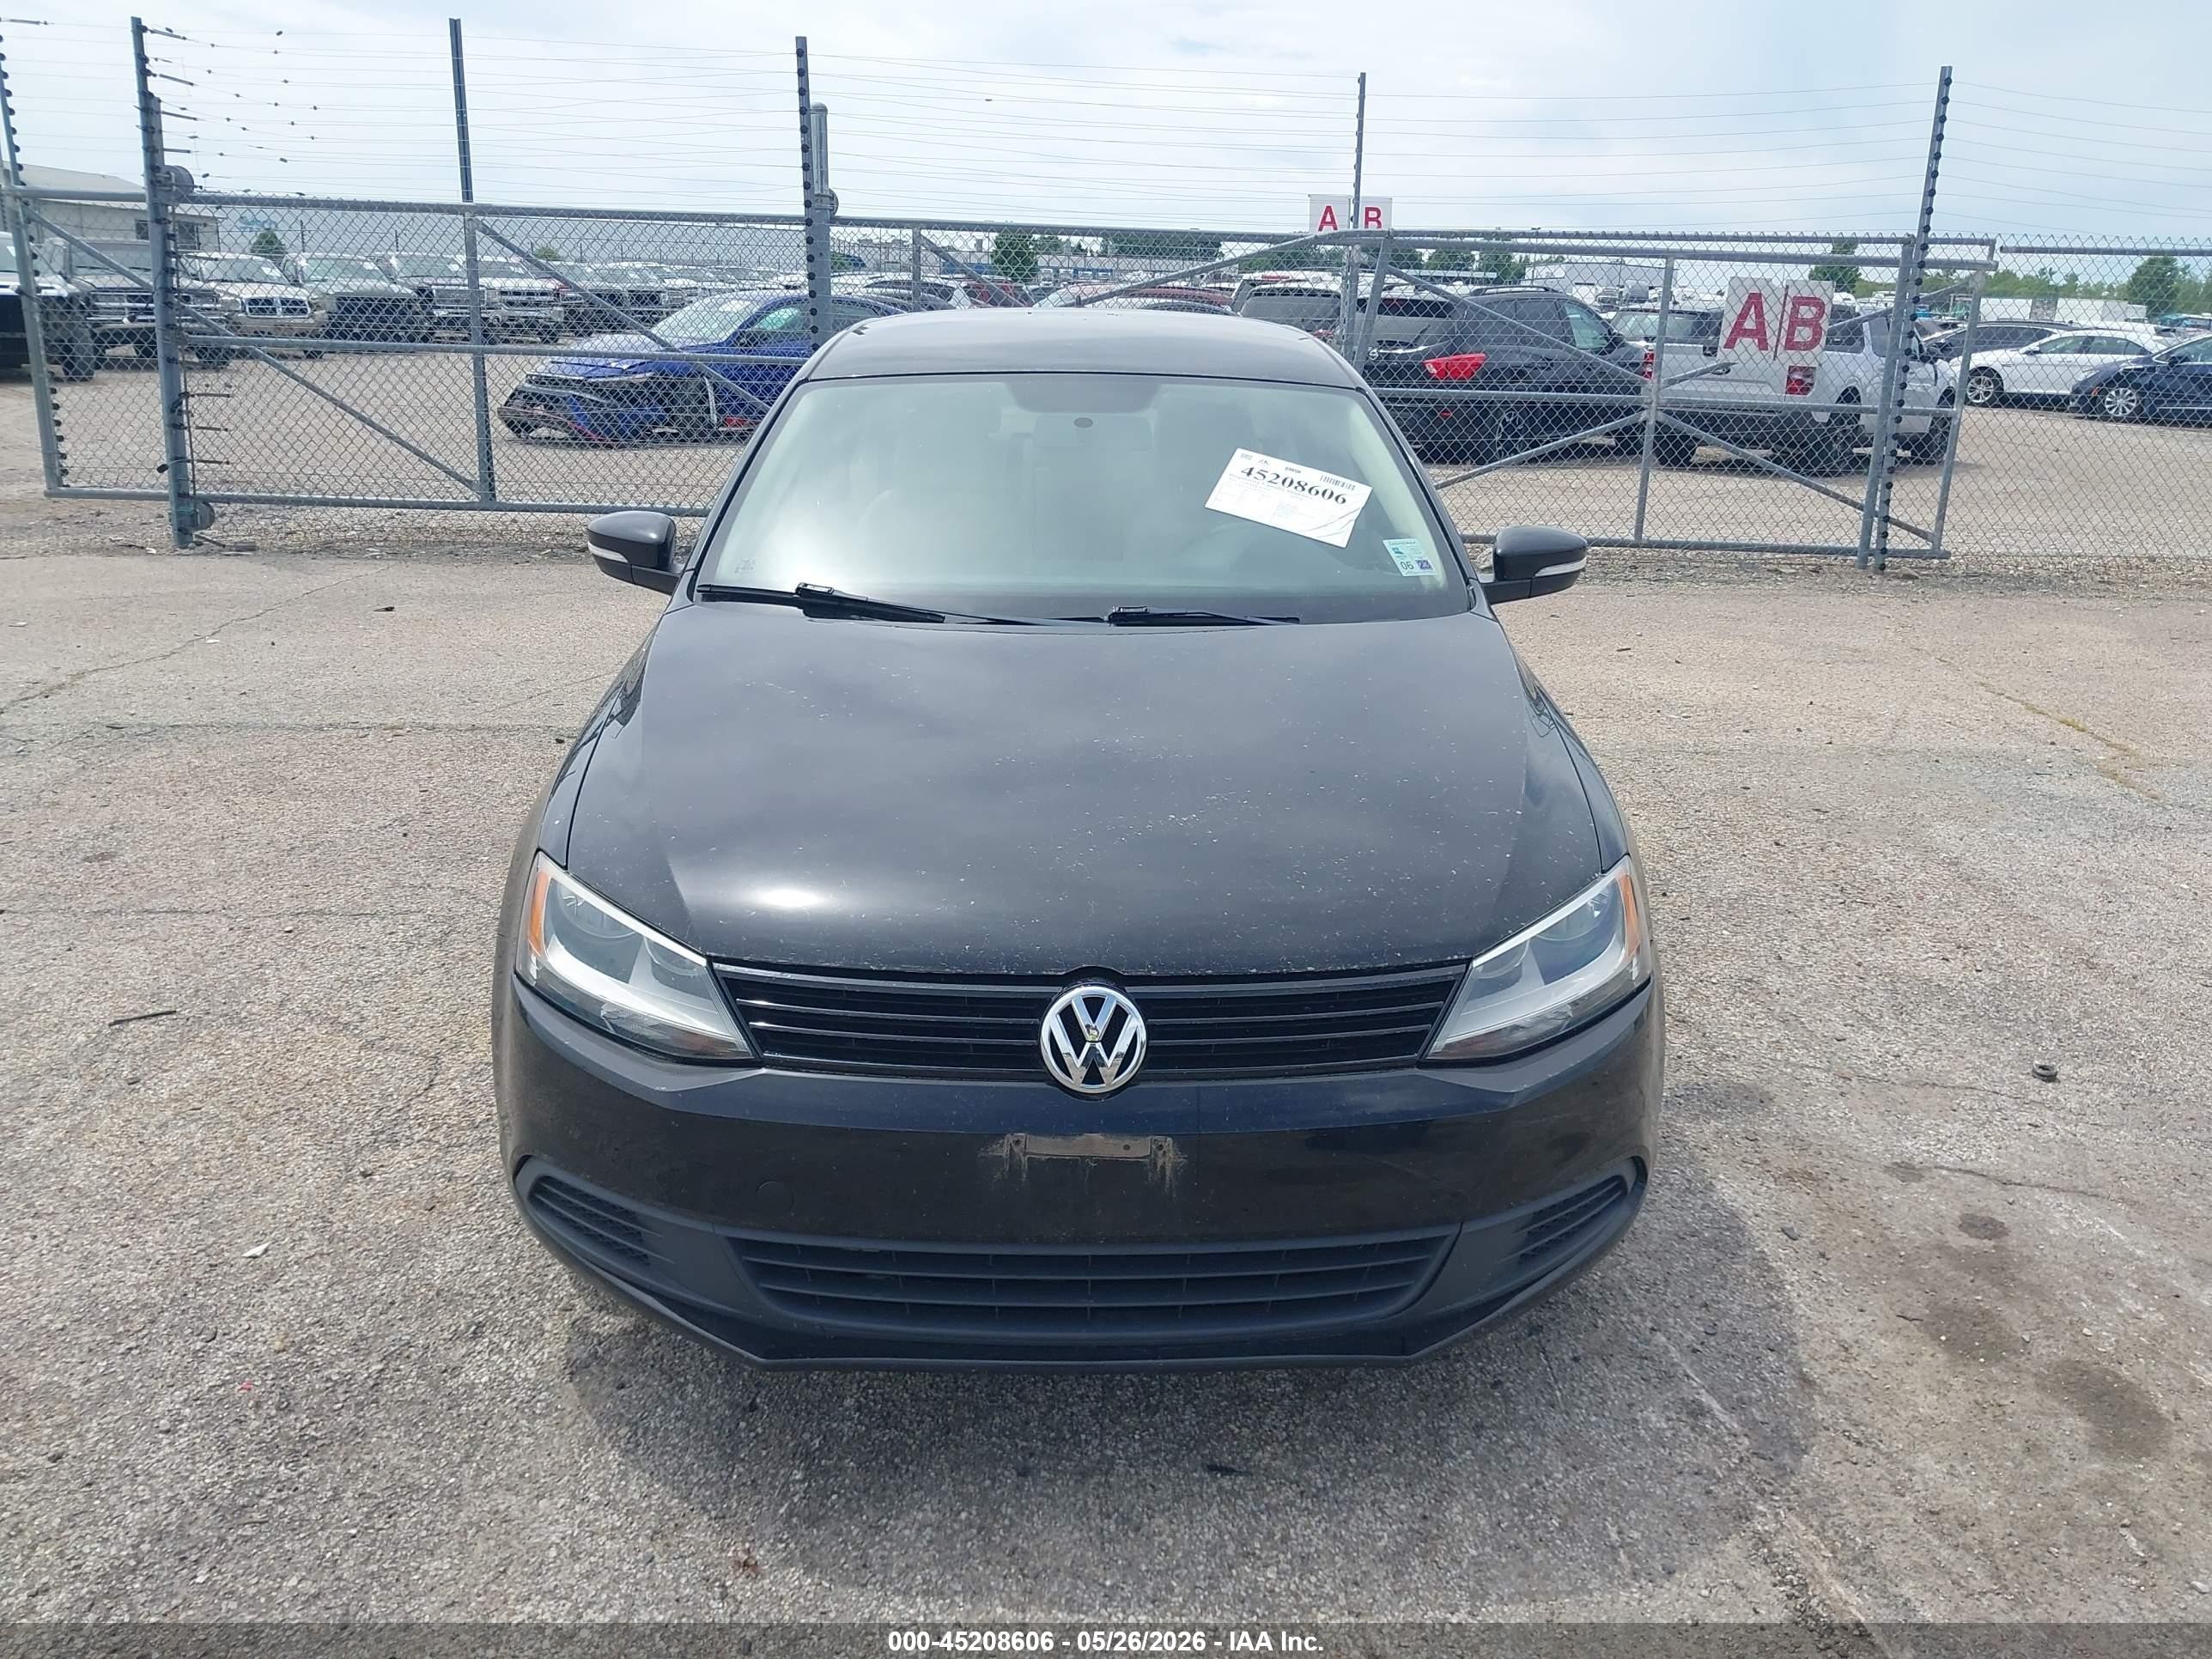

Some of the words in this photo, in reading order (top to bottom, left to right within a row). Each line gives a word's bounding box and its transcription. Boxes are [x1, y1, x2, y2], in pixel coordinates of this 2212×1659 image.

[1318, 205, 1338, 232] A
[1723, 292, 1769, 351] A
[1784, 295, 1826, 351] B
[1241, 466, 1347, 505] 45208606
[1400, 561, 1414, 570] 06
[1416, 560, 1432, 570] 23
